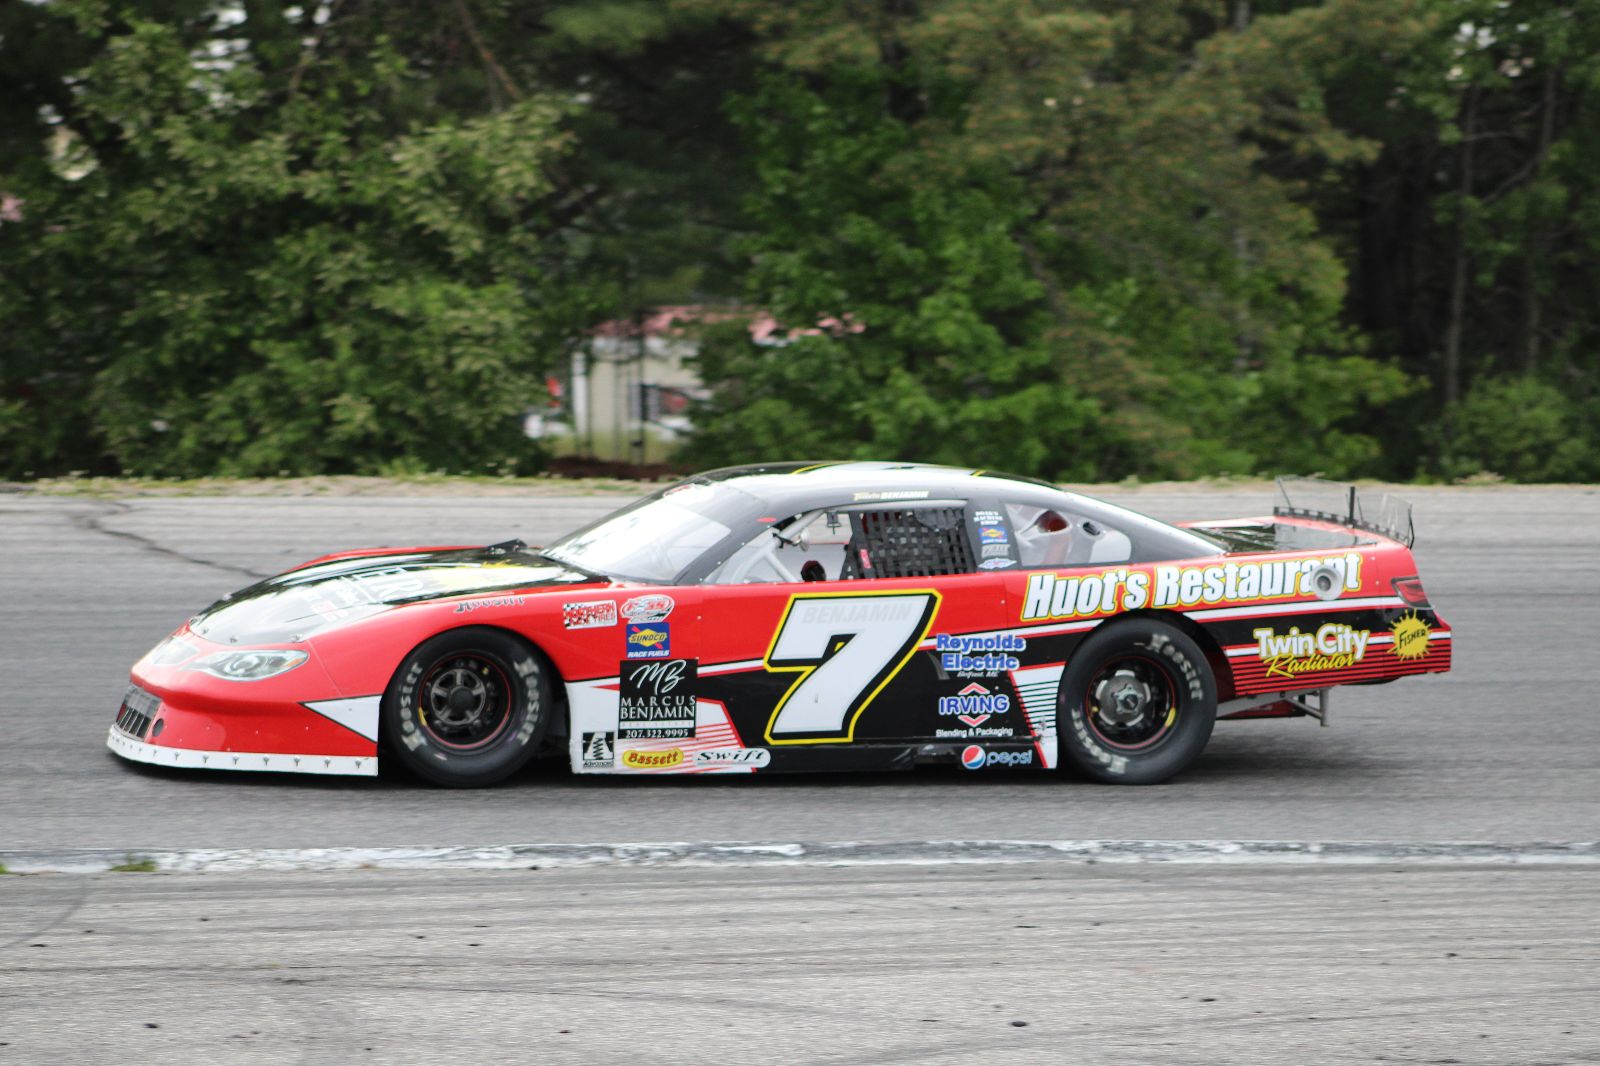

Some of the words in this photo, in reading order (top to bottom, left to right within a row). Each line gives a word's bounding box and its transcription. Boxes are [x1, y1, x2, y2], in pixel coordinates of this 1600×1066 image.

[1021, 566, 1150, 622] Huot's
[802, 604, 912, 625] BENJAMIN
[630, 632, 667, 643] SUNOCO
[936, 633, 1026, 654] Reynolds
[1253, 625, 1317, 660] Twin
[1316, 623, 1370, 661] City
[1398, 628, 1427, 650] FISHER
[627, 650, 647, 659] RACE
[647, 649, 670, 657] FUELS
[941, 653, 1020, 672] Electric
[763, 588, 942, 745] 7
[1262, 653, 1356, 679] Radiator
[399, 662, 426, 751] Hoosier
[620, 695, 696, 707] MARCUS
[938, 694, 1010, 715] IRVING
[620, 706, 696, 721] BENJAMIN
[625, 729, 689, 739] 207.322.9995
[935, 728, 967, 739] Blending
[968, 727, 975, 737] &
[975, 726, 1014, 738] Packaging
[628, 750, 680, 766] Bassett
[986, 749, 1032, 767] pepsi
